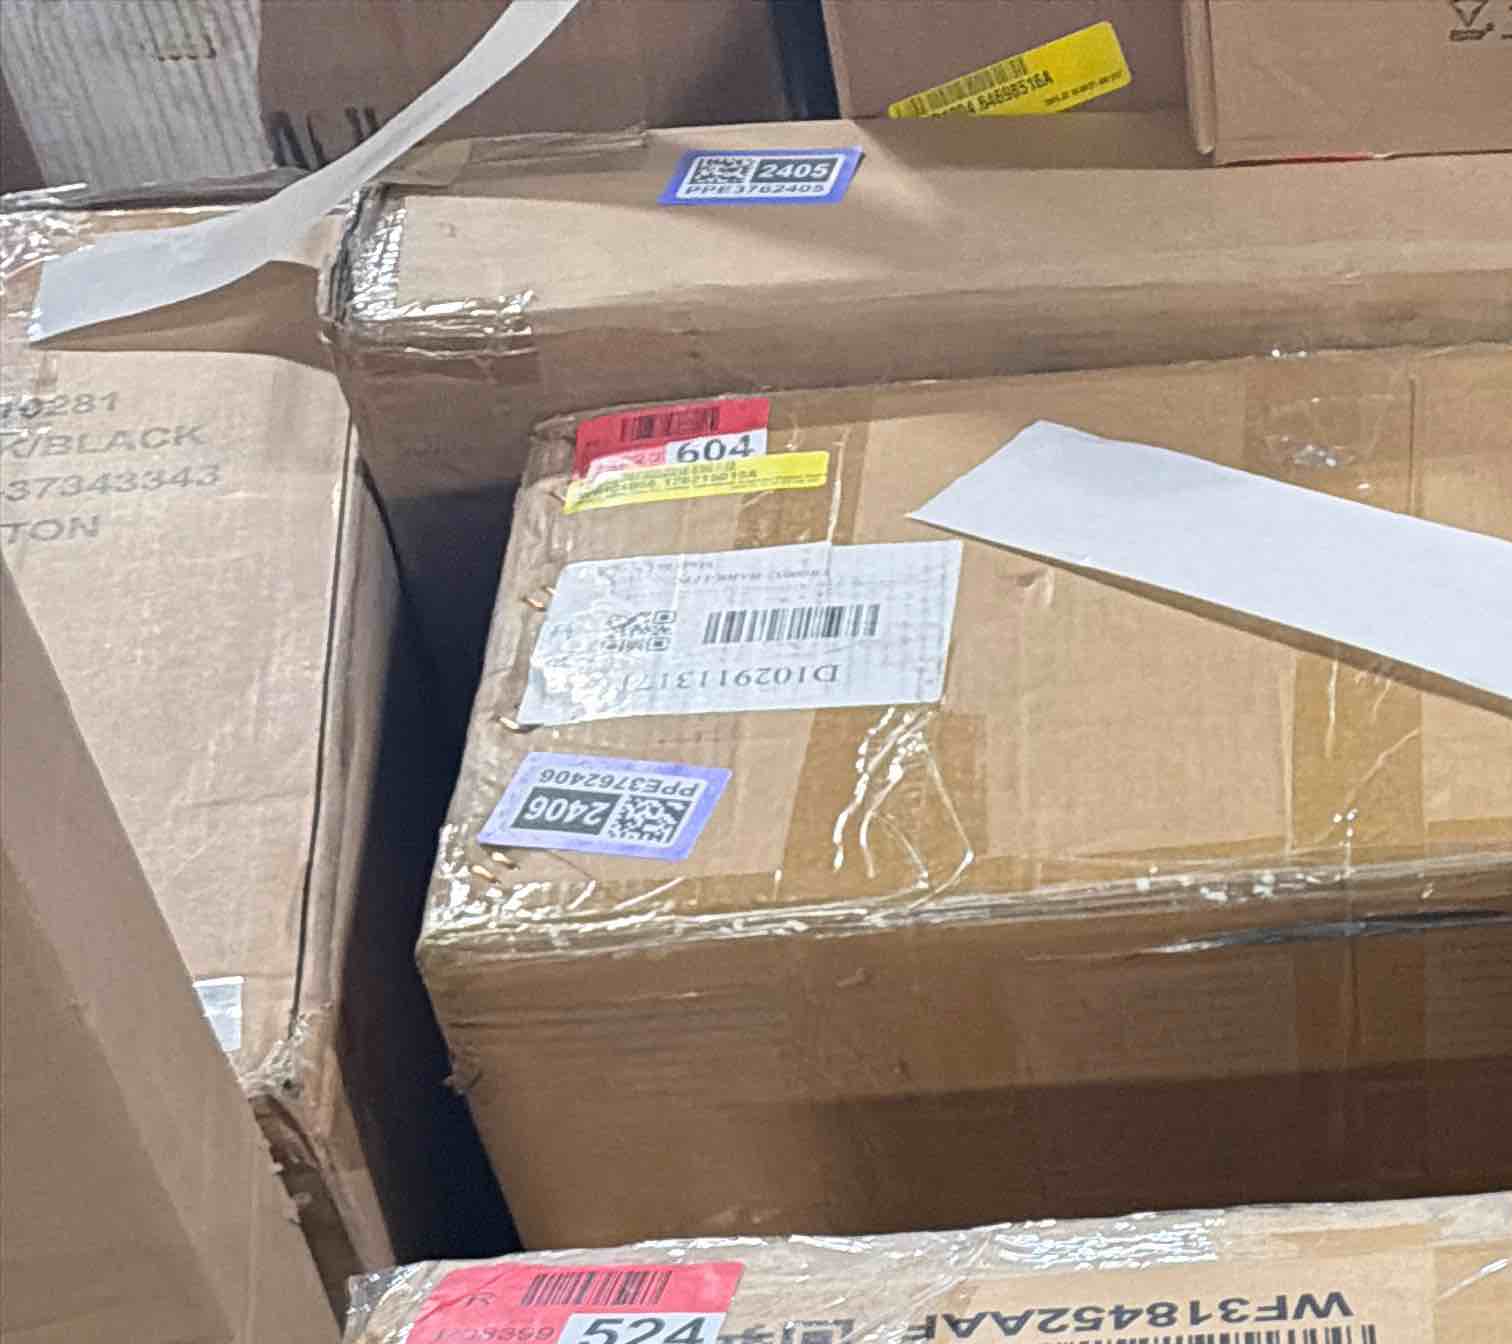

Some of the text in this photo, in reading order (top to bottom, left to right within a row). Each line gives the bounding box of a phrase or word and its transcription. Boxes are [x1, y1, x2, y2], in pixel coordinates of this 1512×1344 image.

[758, 163, 832, 179] 2405
[685, 183, 826, 194] PPE3762405
[676, 434, 755, 463] 604
[539, 768, 700, 798] PPE3762406
[524, 796, 611, 826] 2406
[897, 1290, 1354, 1342] WF318452AAF
